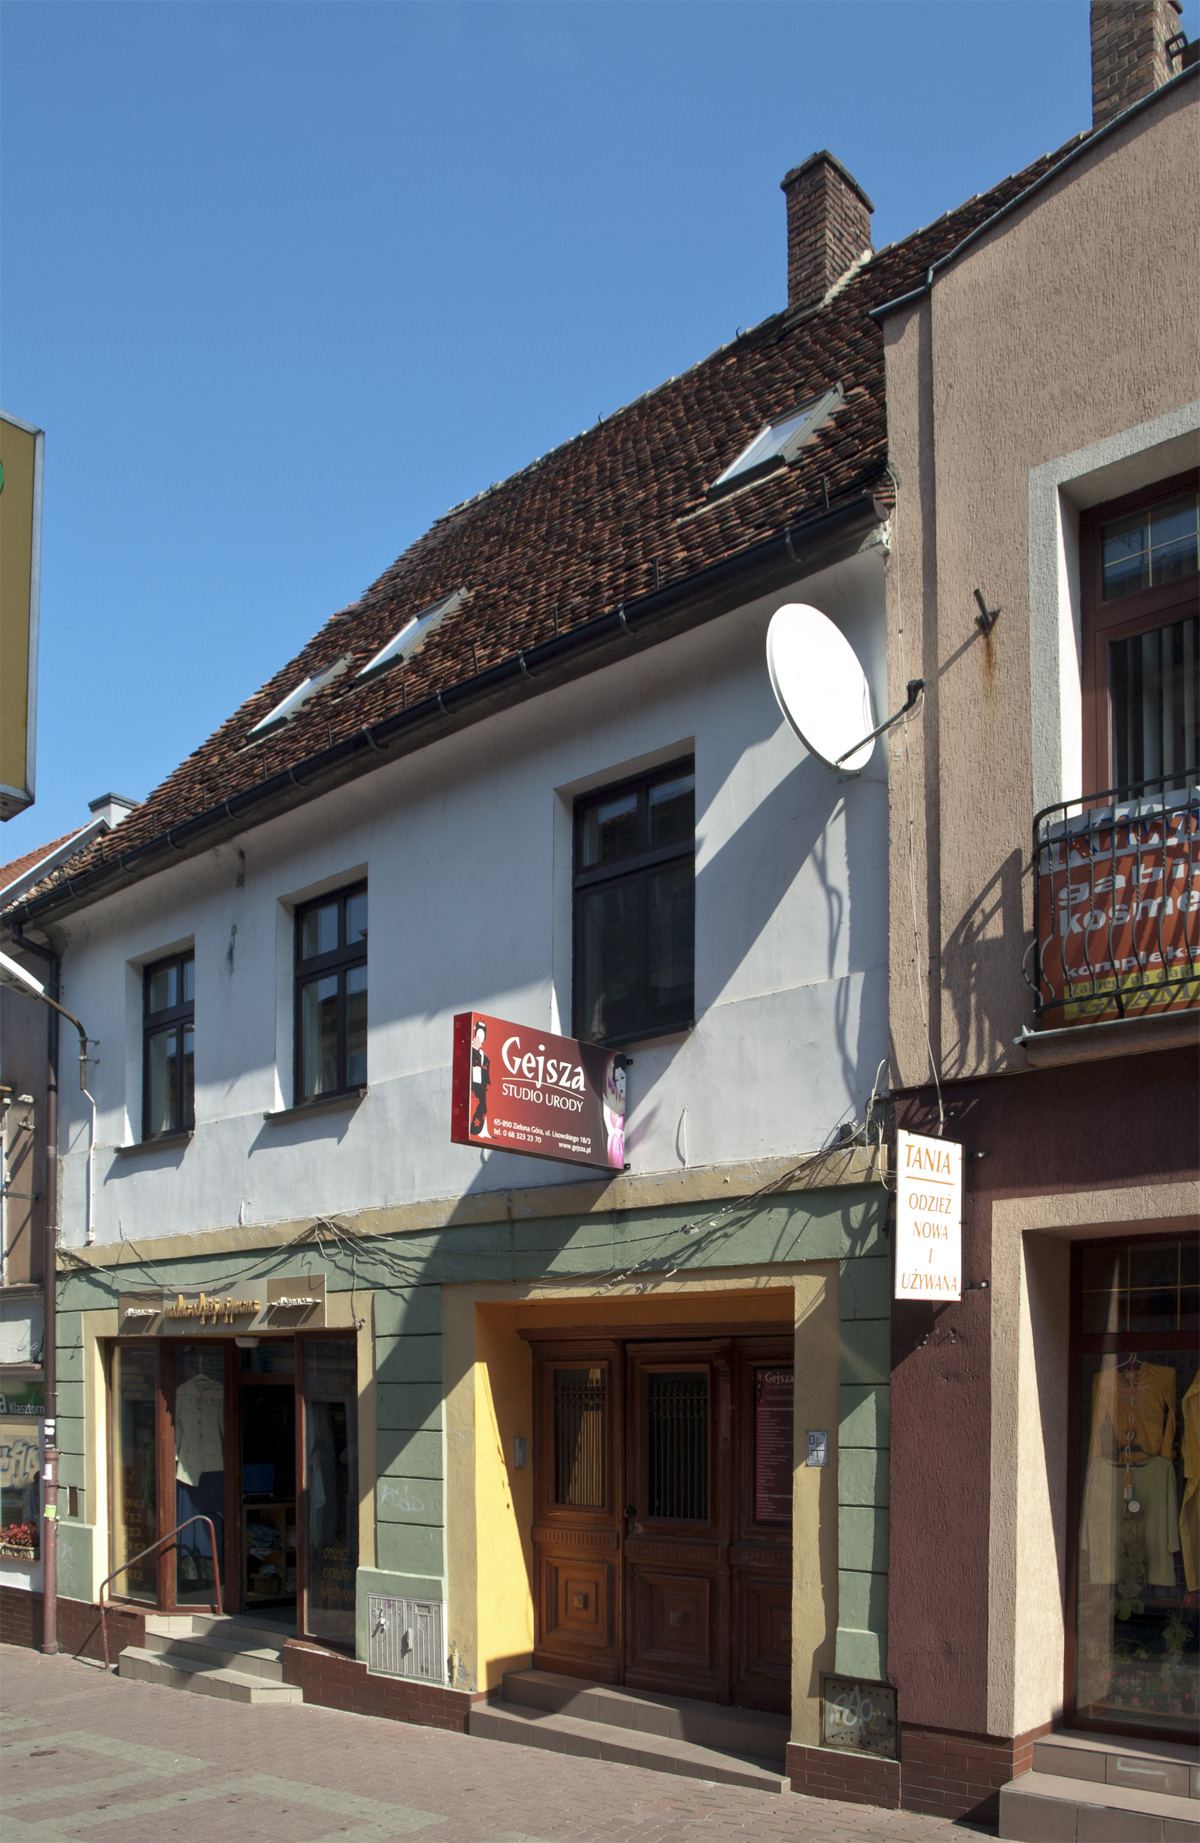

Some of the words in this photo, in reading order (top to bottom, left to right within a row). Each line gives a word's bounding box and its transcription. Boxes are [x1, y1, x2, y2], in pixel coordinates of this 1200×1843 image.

[501, 1036, 586, 1091] Gejsza
[502, 1083, 543, 1103] STUDIO
[545, 1093, 584, 1113] URODY
[493, 1128, 502, 1136] tel.
[527, 1134, 534, 1142] 23
[534, 1136, 542, 1144] 70
[513, 1122, 530, 1132] Zielona
[558, 1142, 592, 1154] www.gejsza.pl
[905, 1144, 952, 1175] TANIA
[908, 1192, 952, 1214] ODZIEŻ
[913, 1220, 949, 1241] NOWA
[928, 1247, 934, 1264] I
[901, 1267, 958, 1292] UŻYWANA
